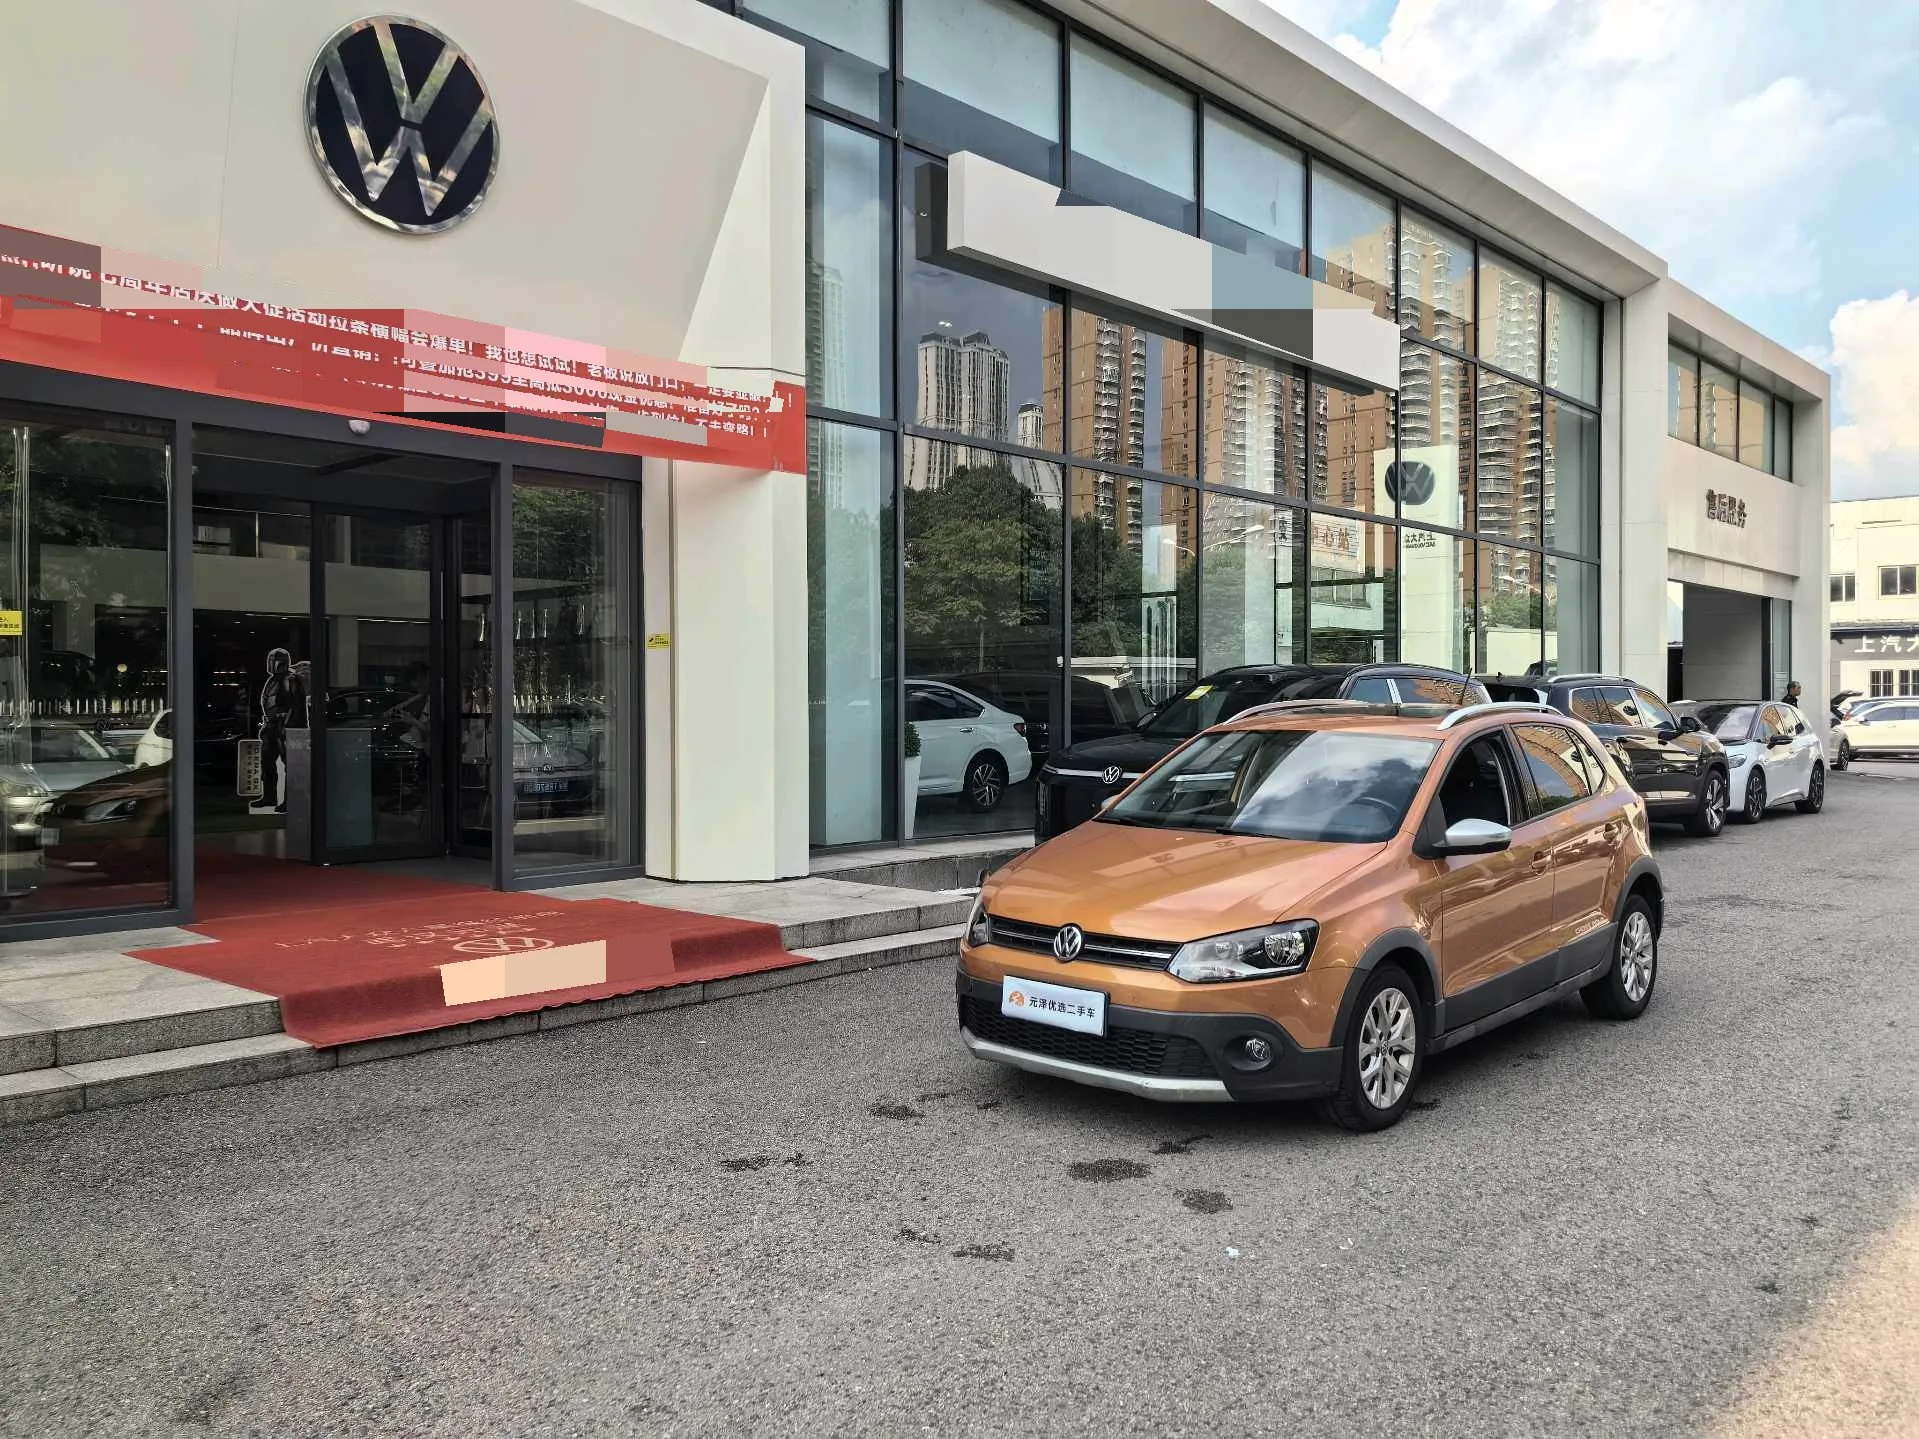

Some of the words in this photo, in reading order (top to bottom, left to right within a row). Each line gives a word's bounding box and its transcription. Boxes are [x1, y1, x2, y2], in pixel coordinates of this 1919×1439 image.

[1029, 996, 1096, 1018] 元泽优选二手车
